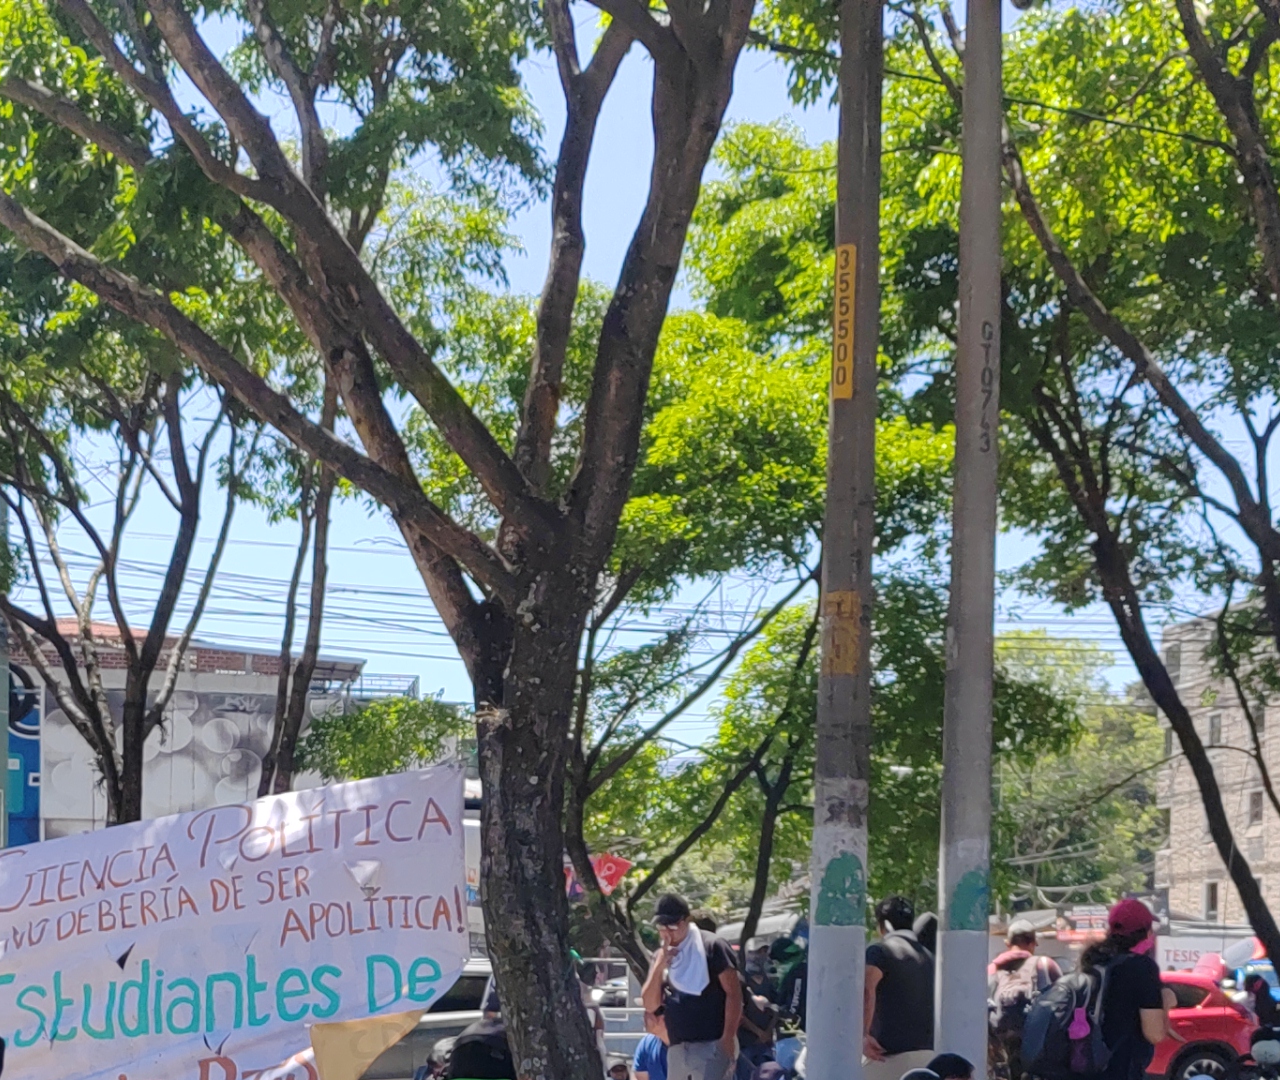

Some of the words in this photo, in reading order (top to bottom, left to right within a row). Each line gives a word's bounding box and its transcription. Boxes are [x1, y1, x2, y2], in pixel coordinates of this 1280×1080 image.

[835, 249, 851, 386] 355500
[187, 797, 452, 868] POLÍTICA
[56, 872, 199, 940] DEBERÍA
[210, 875, 246, 913] DE
[257, 865, 310, 905] SER
[367, 954, 442, 1014] De
[1164, 949, 1201, 963] TESIS
